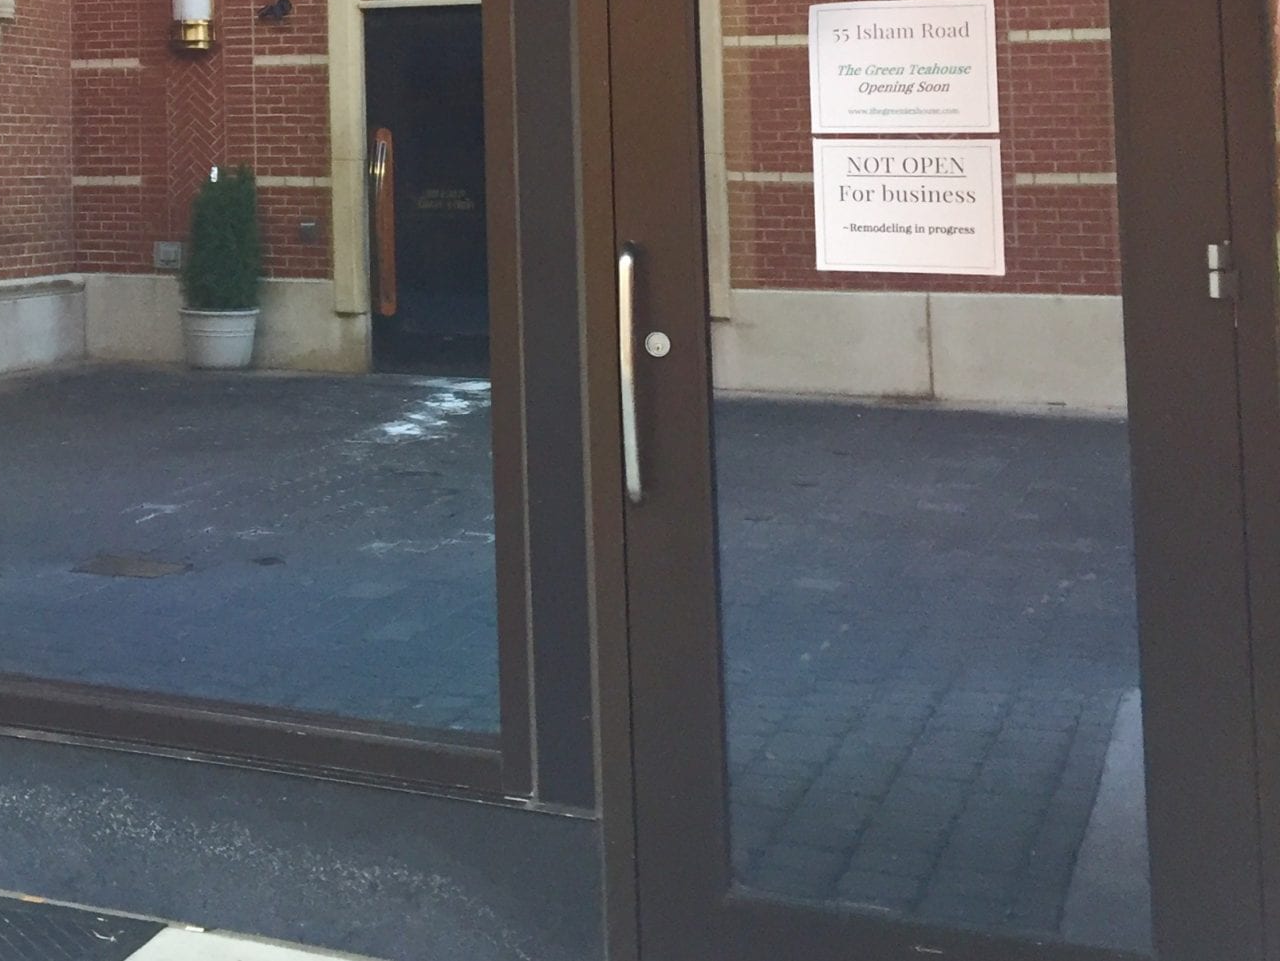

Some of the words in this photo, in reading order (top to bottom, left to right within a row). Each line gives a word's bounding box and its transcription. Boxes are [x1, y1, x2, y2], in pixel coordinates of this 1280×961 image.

[832, 27, 851, 43] 55
[856, 23, 914, 41] Isham
[921, 21, 970, 40] Road
[837, 63, 862, 77] The
[865, 63, 905, 77] Green
[908, 62, 972, 76] Teahouse
[858, 80, 915, 96] Opening
[916, 80, 951, 93] Soon
[846, 156, 896, 174] NOT
[901, 156, 967, 175] OPEN
[839, 184, 876, 203] For
[881, 183, 977, 205] business
[914, 222, 927, 235] in
[927, 224, 977, 237] progress
